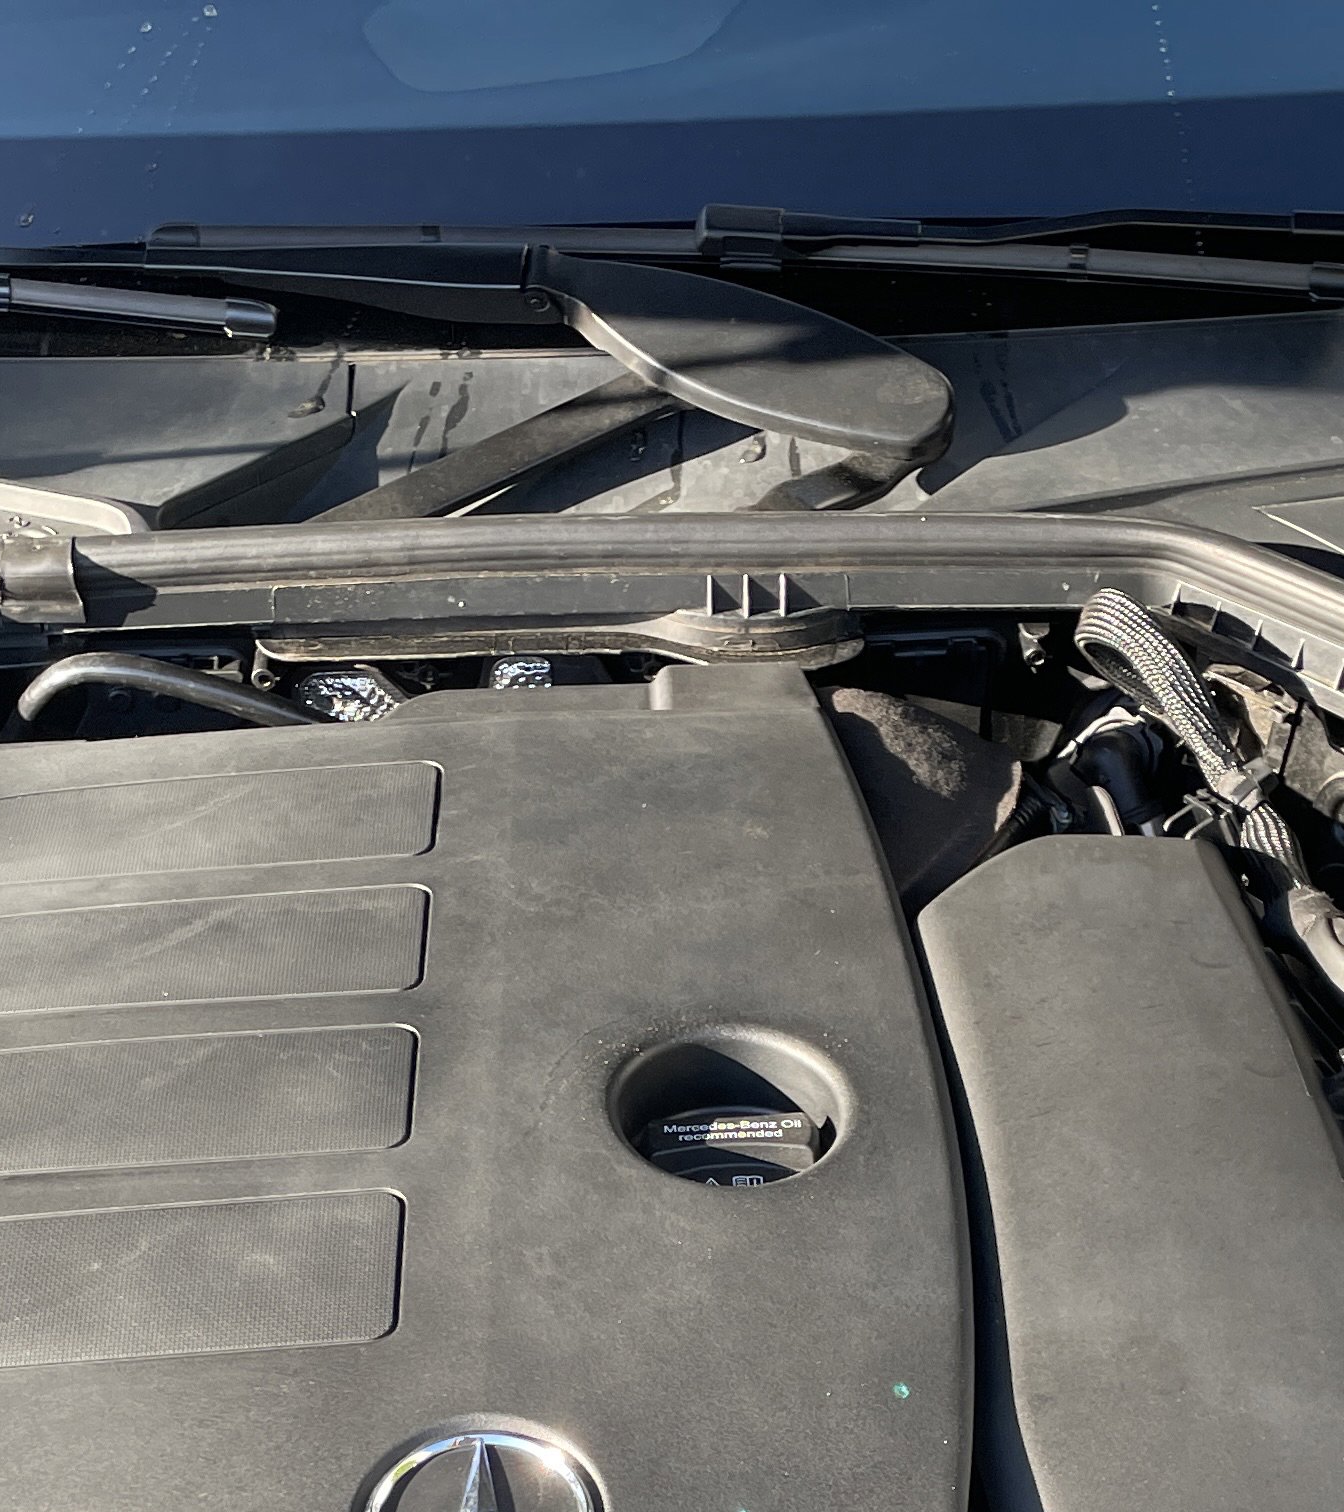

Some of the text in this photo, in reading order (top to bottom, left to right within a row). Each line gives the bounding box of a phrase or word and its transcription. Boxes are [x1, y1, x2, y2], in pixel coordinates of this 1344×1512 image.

[663, 1119, 802, 1133] Mercedes-Benz Oil
[678, 1129, 783, 1141] recommended
